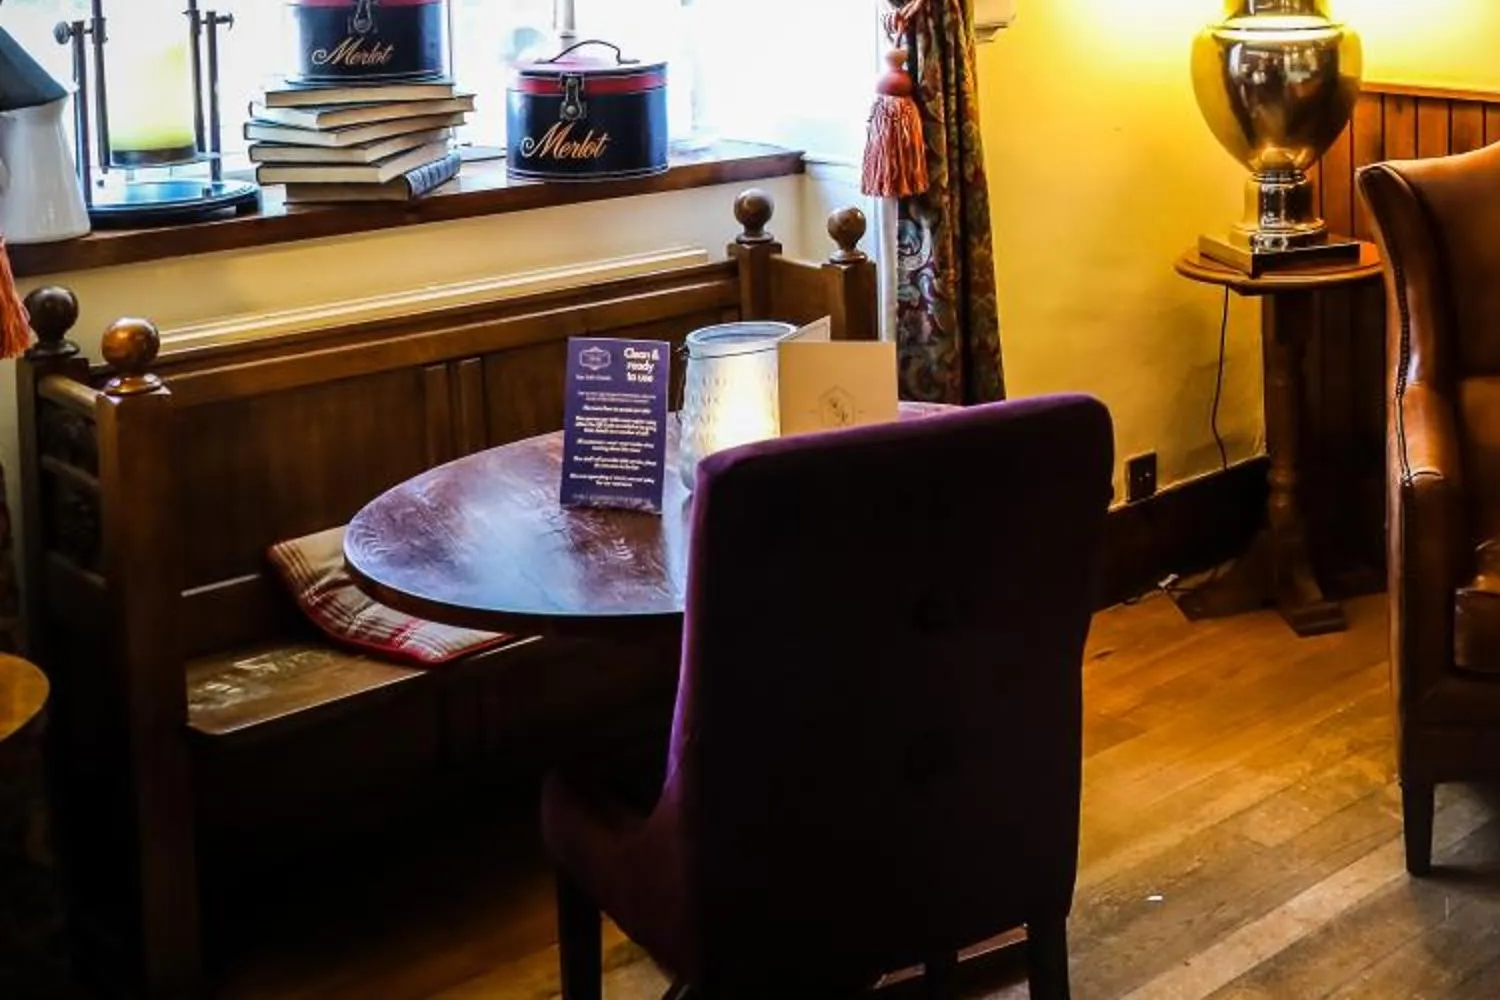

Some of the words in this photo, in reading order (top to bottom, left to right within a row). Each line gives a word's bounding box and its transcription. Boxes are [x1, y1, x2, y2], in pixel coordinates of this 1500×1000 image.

[311, 37, 394, 65] Merlot
[521, 121, 611, 159] Merlot
[623, 347, 650, 360] Clean
[651, 349, 660, 361] &
[626, 360, 655, 375] ready
[627, 371, 637, 381] to
[638, 373, 654, 383] use
